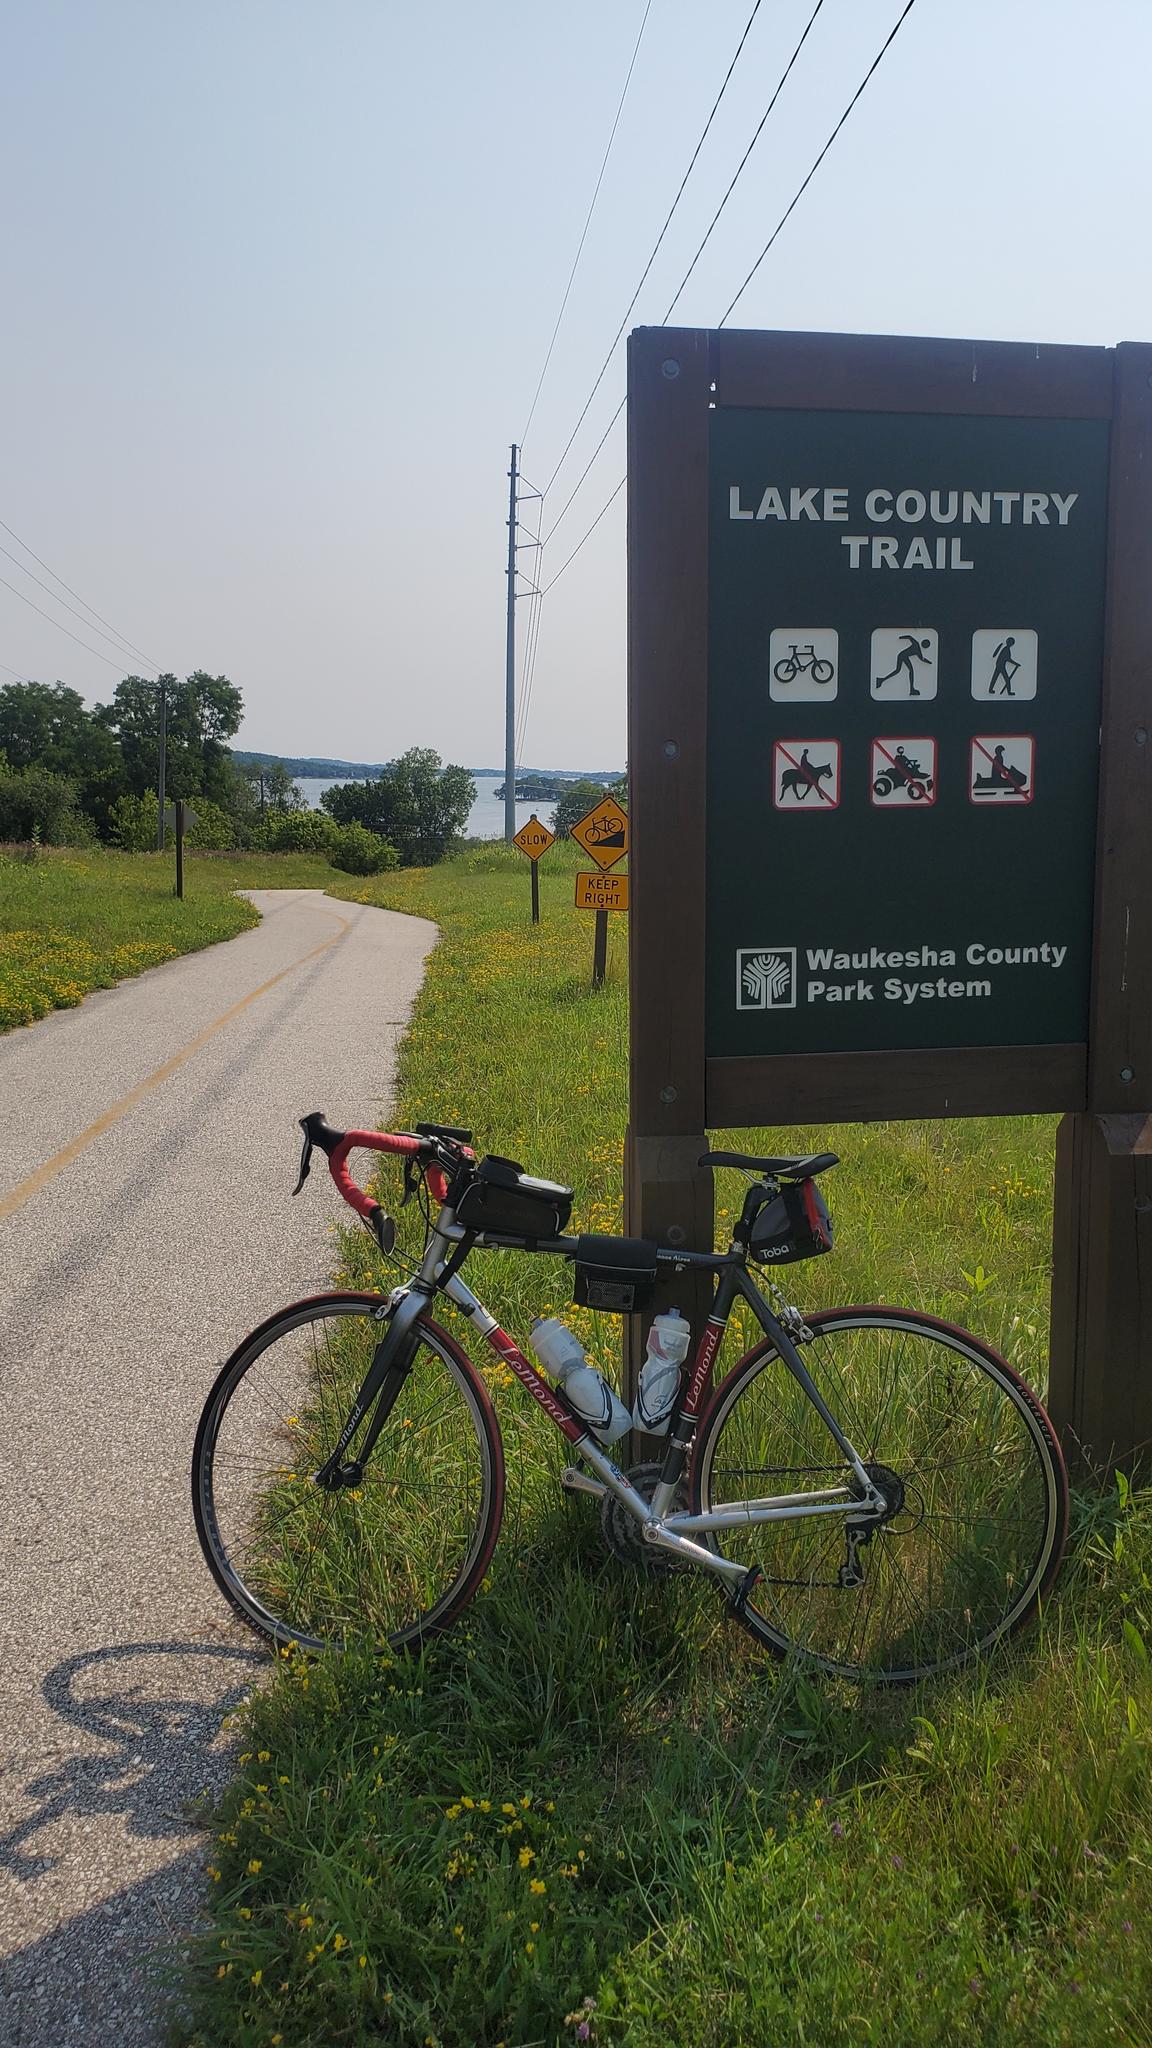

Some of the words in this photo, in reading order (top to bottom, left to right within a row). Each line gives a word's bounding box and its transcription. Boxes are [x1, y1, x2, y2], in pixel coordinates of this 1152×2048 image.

[729, 486, 849, 521] LAKE
[865, 489, 1079, 525] COUNTRY
[841, 535, 975, 570] TRAIL
[520, 834, 548, 845] SLOW
[584, 892, 621, 905] RIGHT
[588, 878, 619, 891] KEEP
[806, 946, 956, 971] Waukesha
[966, 942, 1067, 968] County
[807, 979, 874, 1002] Park
[884, 977, 991, 1004] System
[1017, 1385, 1053, 1446] BONTRAGER
[231, 1600, 273, 1640] ONTRAGER
